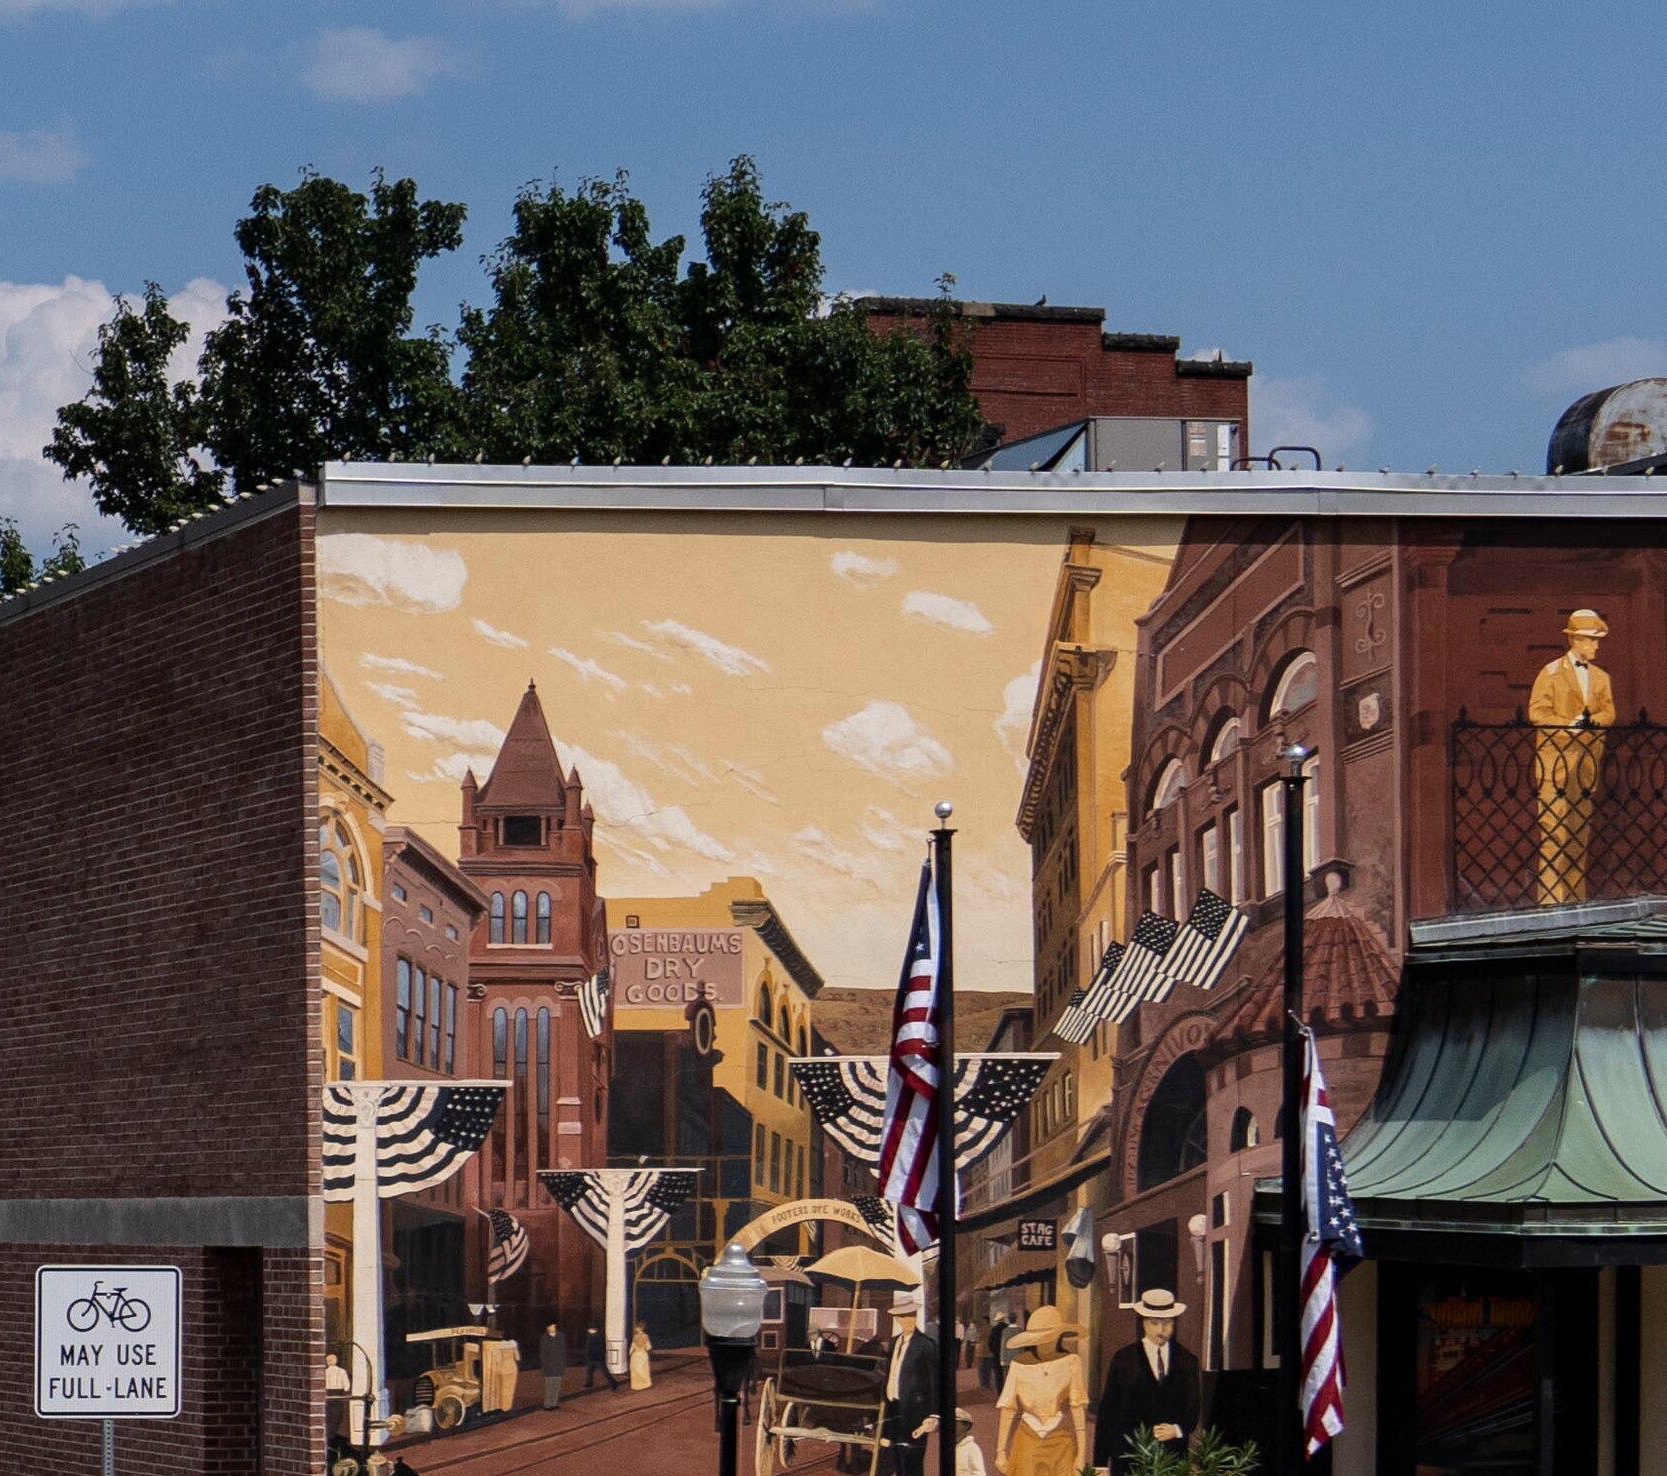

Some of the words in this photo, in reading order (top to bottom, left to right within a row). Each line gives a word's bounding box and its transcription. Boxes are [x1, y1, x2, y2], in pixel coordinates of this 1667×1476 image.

[644, 958, 704, 980] DRY
[1021, 1223, 1054, 1235] STAG
[1021, 1235, 1053, 1245] CAFE
[60, 1344, 103, 1366] MAY
[117, 1344, 157, 1366] USE
[49, 1377, 101, 1399] FULL
[115, 1377, 167, 1399] LANE
